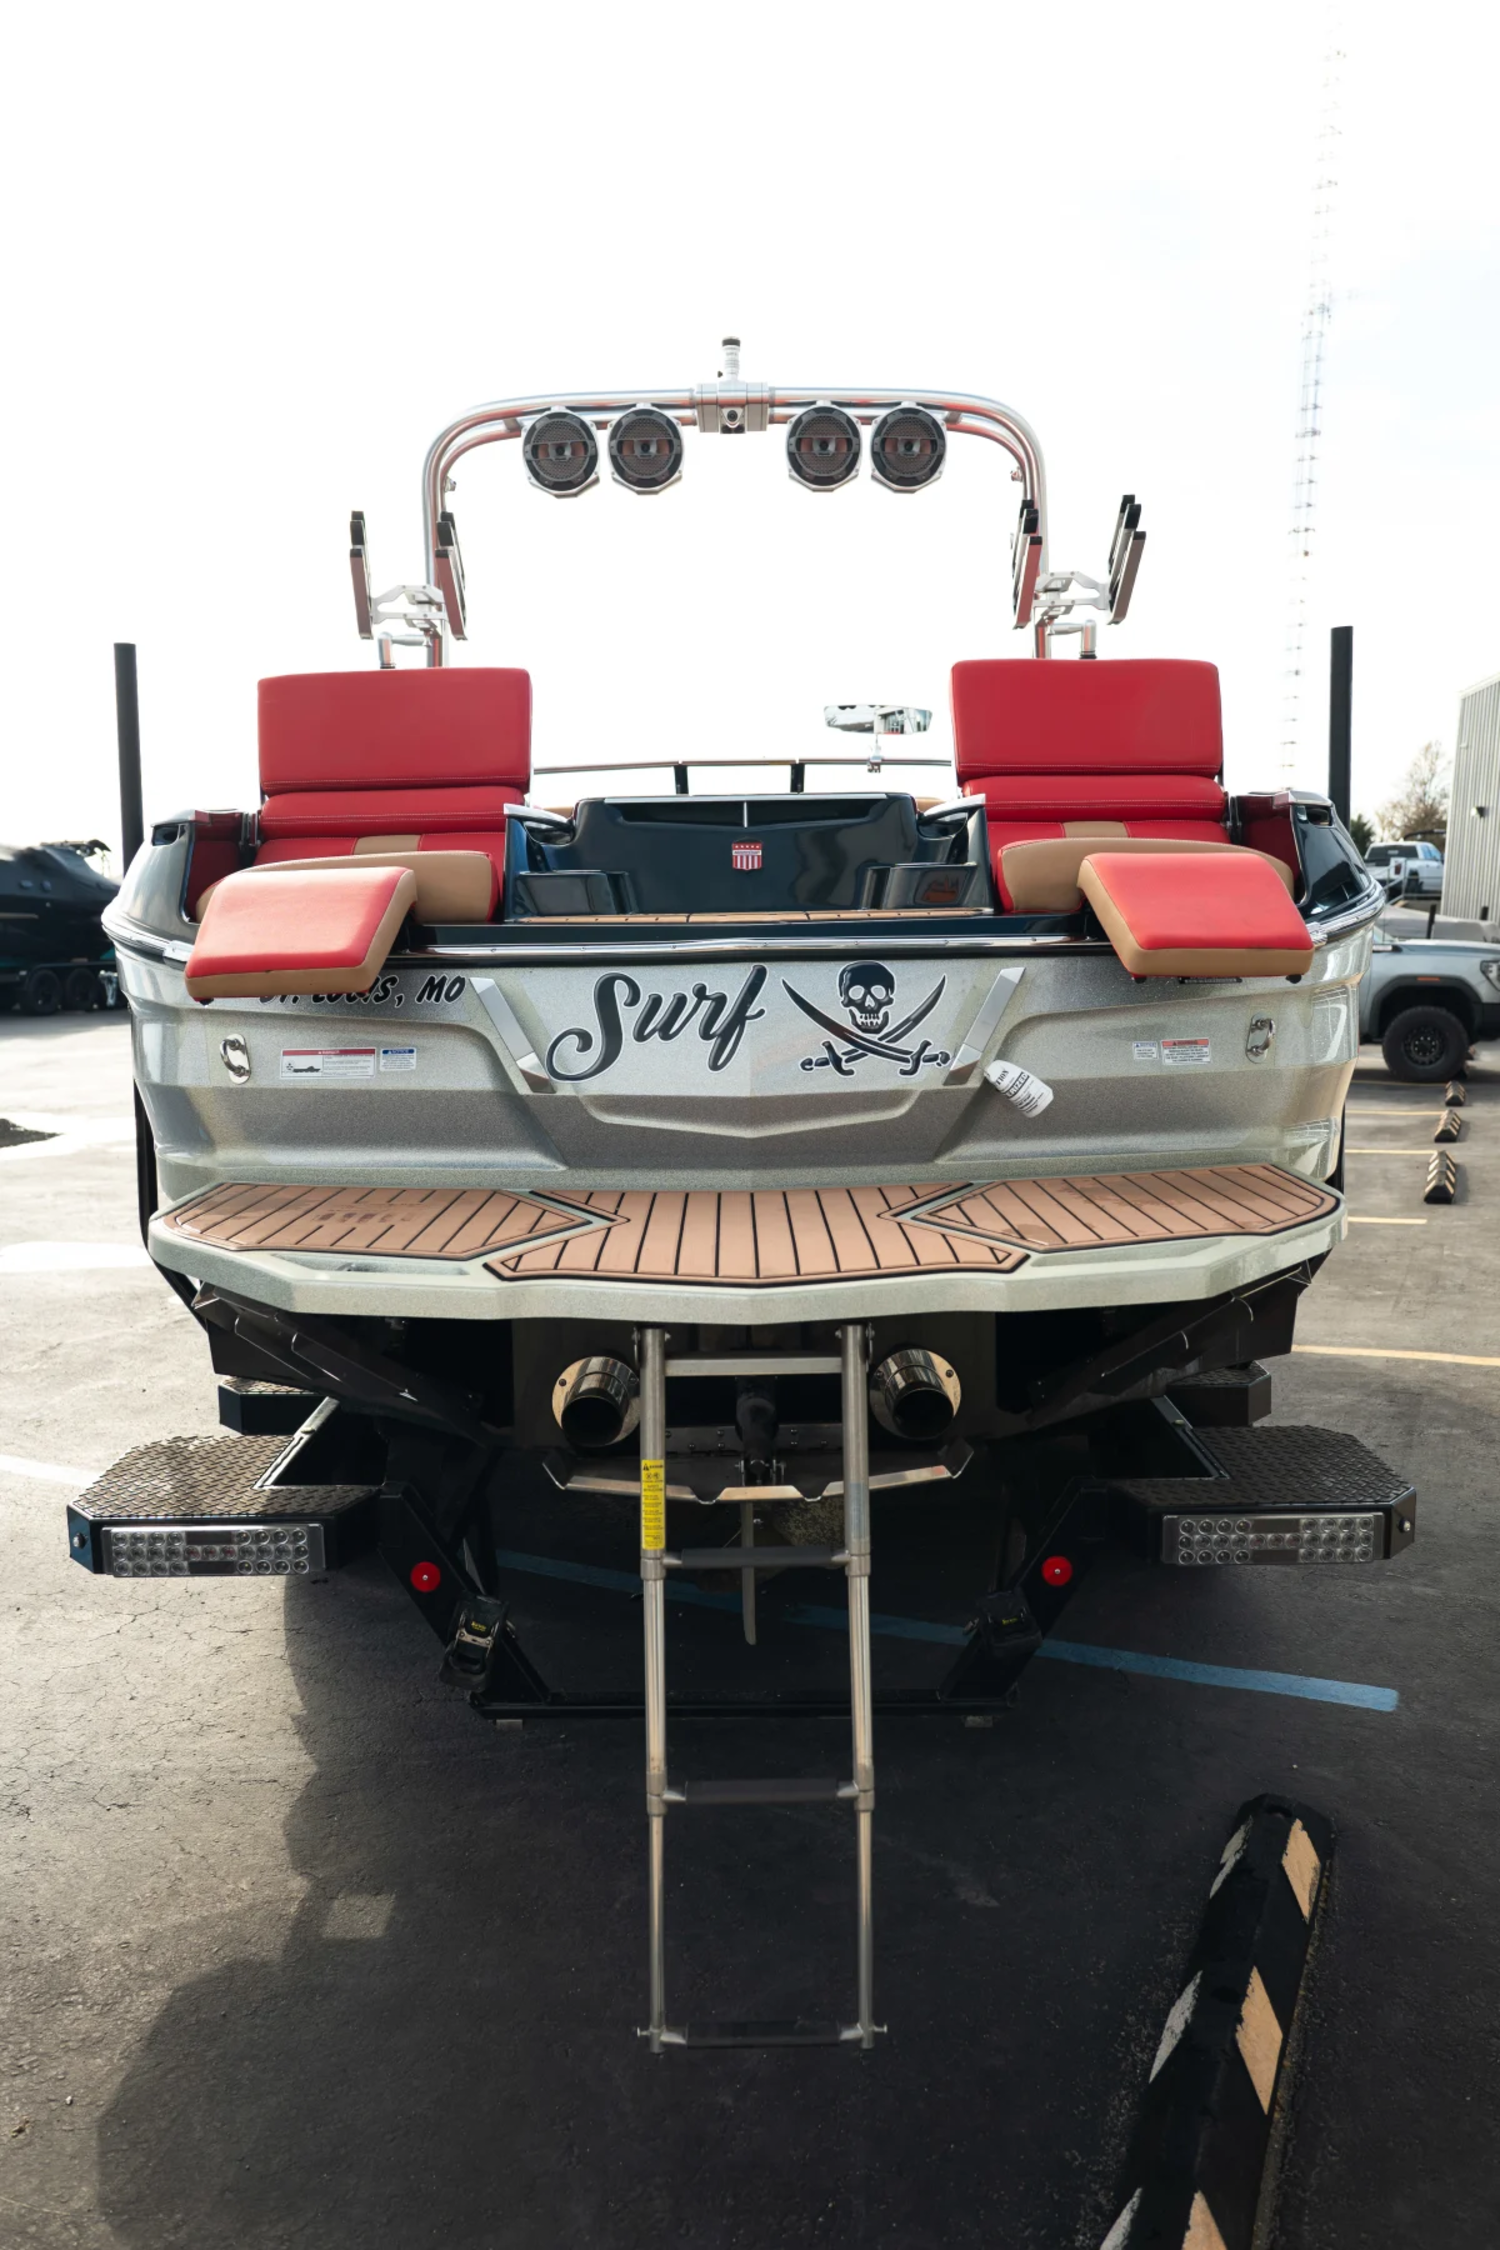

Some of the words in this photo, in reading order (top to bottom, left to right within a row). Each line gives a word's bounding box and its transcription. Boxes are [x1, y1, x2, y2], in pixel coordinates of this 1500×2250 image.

[415, 974, 466, 1004] MO
[545, 964, 768, 1084] Surf
[994, 1069, 1009, 1086] TION
[1005, 1072, 1029, 1098] ERIZED
